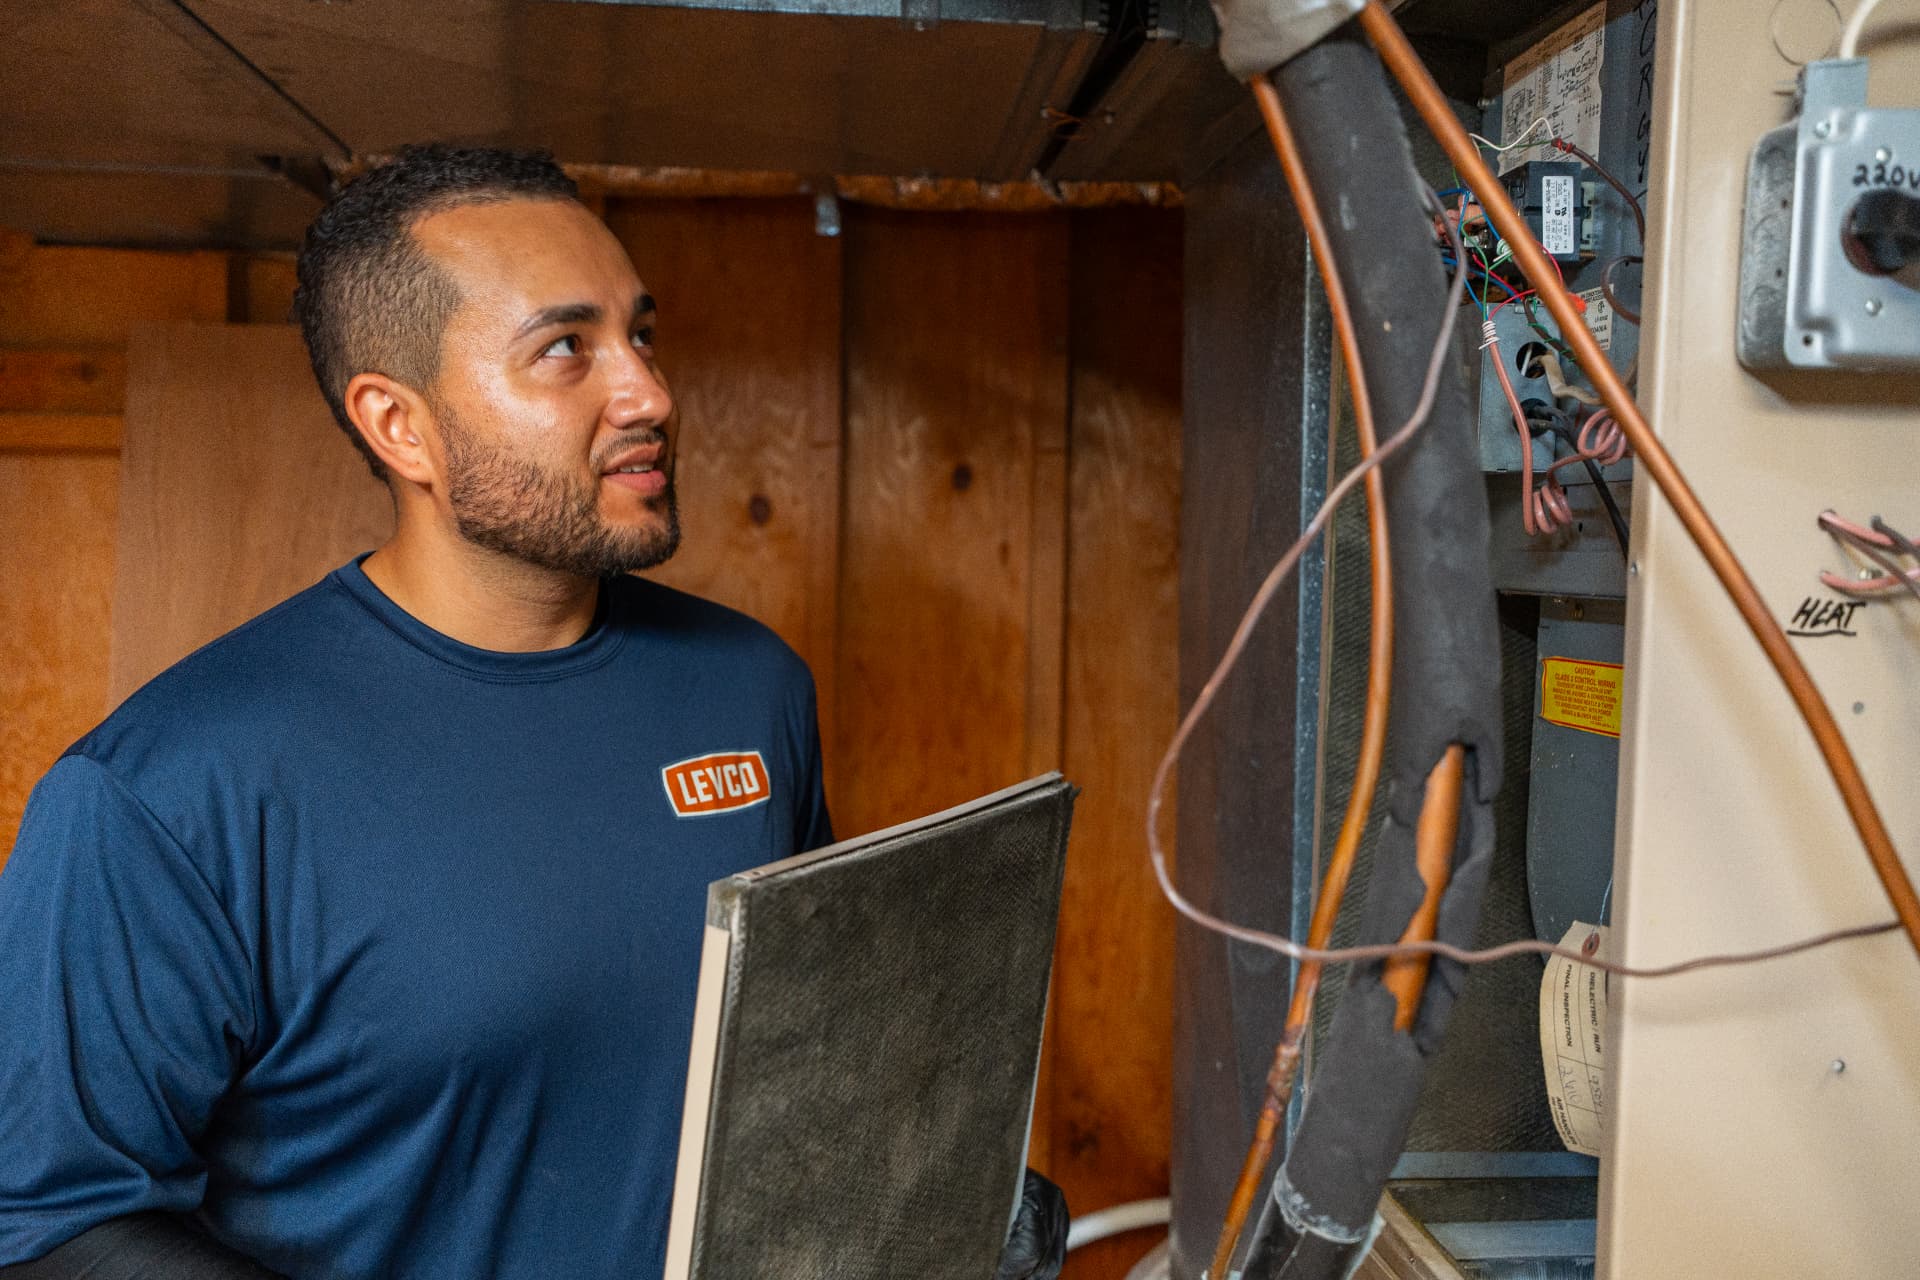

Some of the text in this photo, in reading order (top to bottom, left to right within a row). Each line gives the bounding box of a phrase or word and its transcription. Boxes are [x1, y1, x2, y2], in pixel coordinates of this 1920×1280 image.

[1791, 597, 1866, 629] HEAT
[1575, 666, 1595, 675] CAUTION
[1575, 676, 1595, 685] CONTROL
[677, 762, 760, 806] LEVCO
[1563, 964, 1573, 1047] FINAL INSPECTION
[1589, 972, 1598, 1027] DIELECTRIC
[1593, 1033, 1601, 1053] RUN
